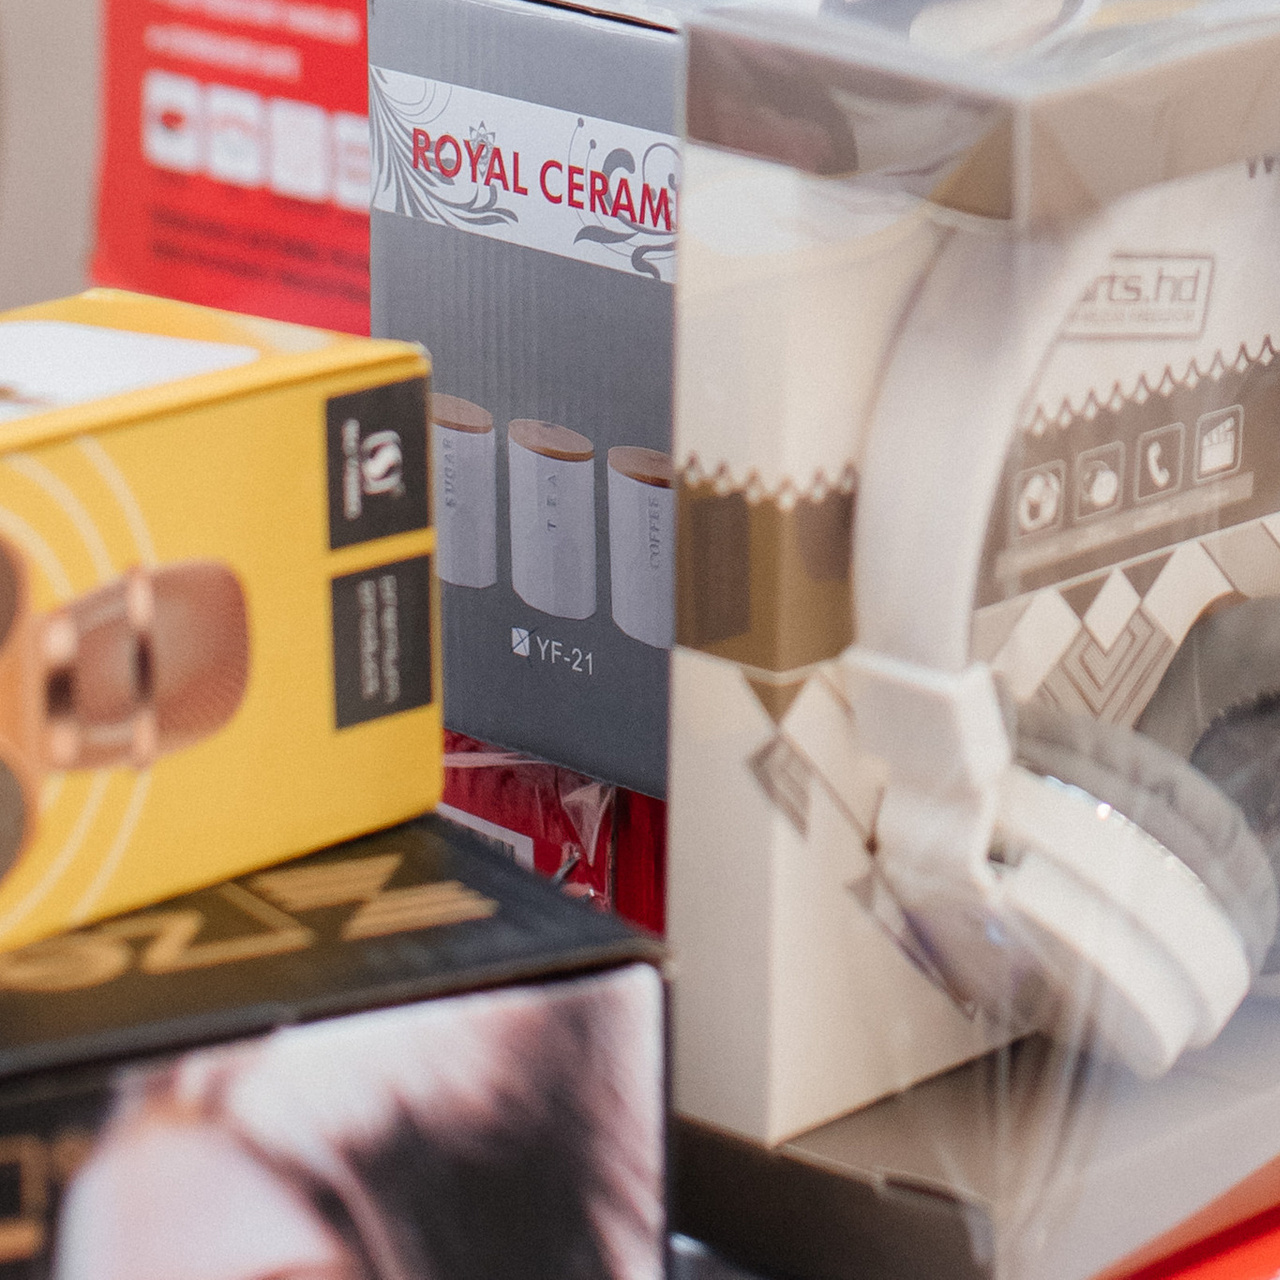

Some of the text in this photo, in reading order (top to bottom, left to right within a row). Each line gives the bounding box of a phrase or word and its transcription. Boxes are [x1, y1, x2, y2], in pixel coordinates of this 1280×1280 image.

[412, 127, 679, 232] ROYAL CERAM
[546, 473, 559, 531] TEA
[647, 495, 662, 572] COFFEE
[536, 639, 595, 676] YF-21
